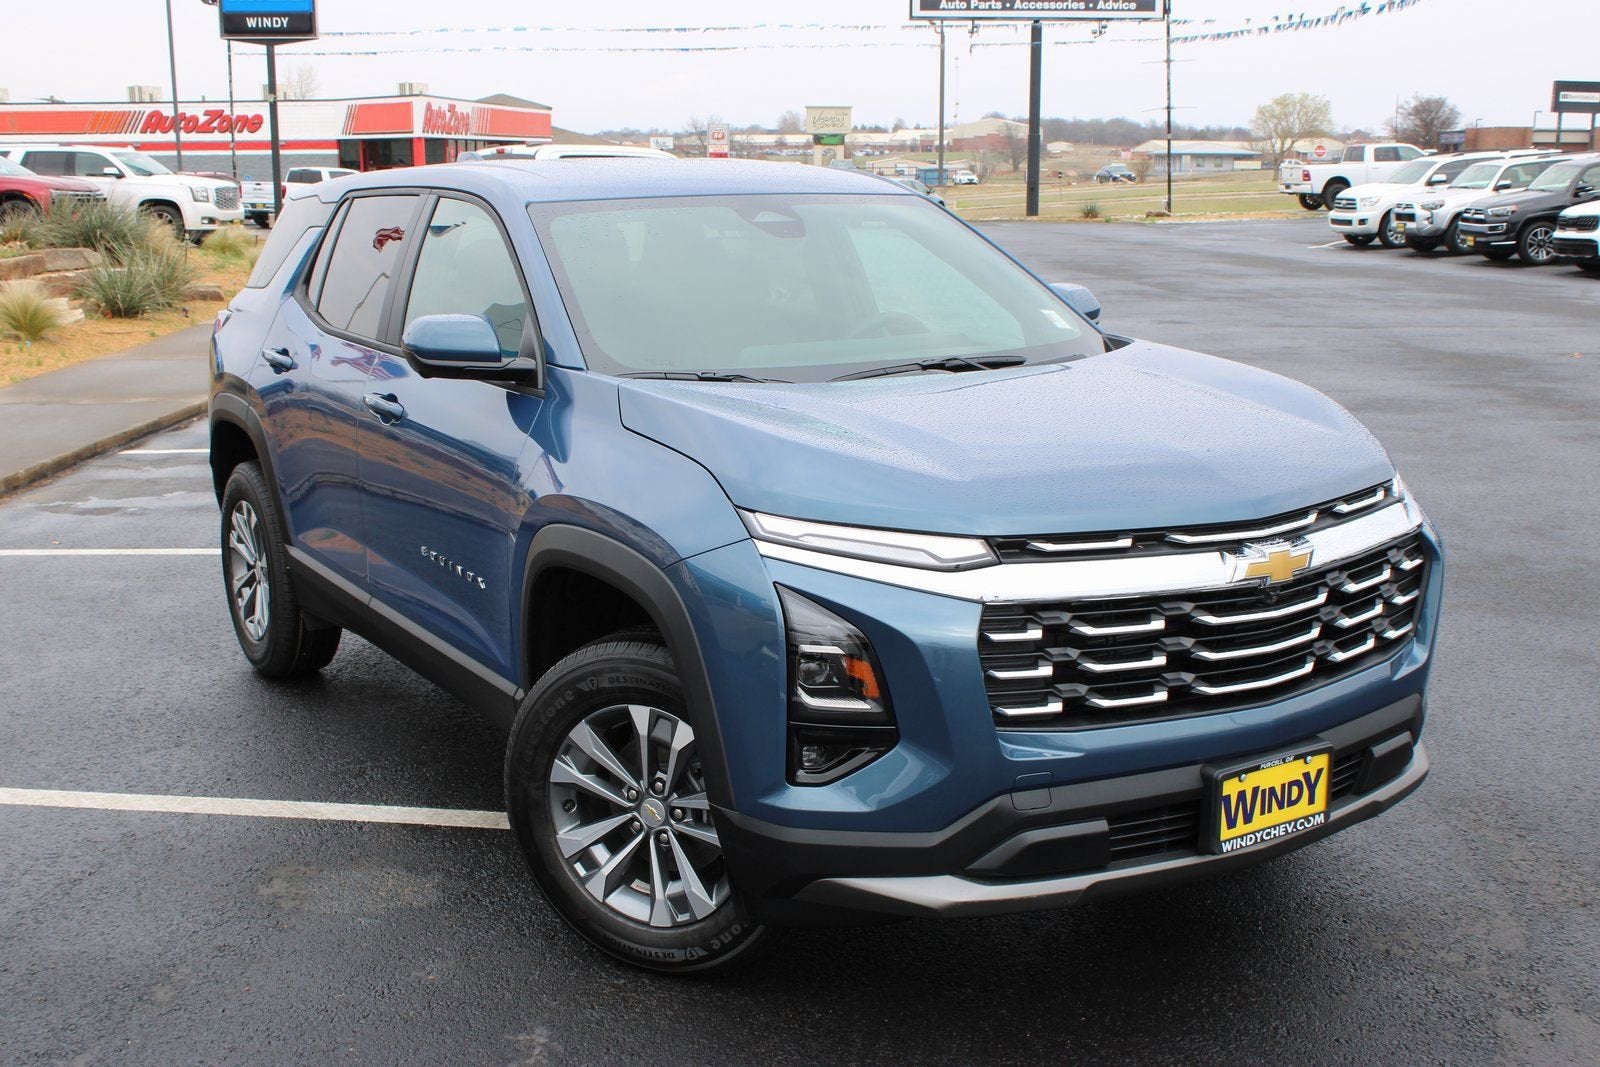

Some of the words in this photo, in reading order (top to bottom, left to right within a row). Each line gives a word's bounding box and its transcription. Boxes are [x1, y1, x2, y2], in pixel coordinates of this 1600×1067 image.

[939, 0, 967, 9] Auto
[970, 0, 1002, 9] Parts
[1013, 0, 1086, 10] Accessories
[1096, 0, 1137, 10] Advice
[245, 16, 289, 28] WINDY
[140, 109, 264, 134] AutoZone
[423, 101, 470, 136] AutoZone
[1221, 767, 1325, 831] WINDY
[1221, 813, 1325, 853] WINDYCHEV.COM
